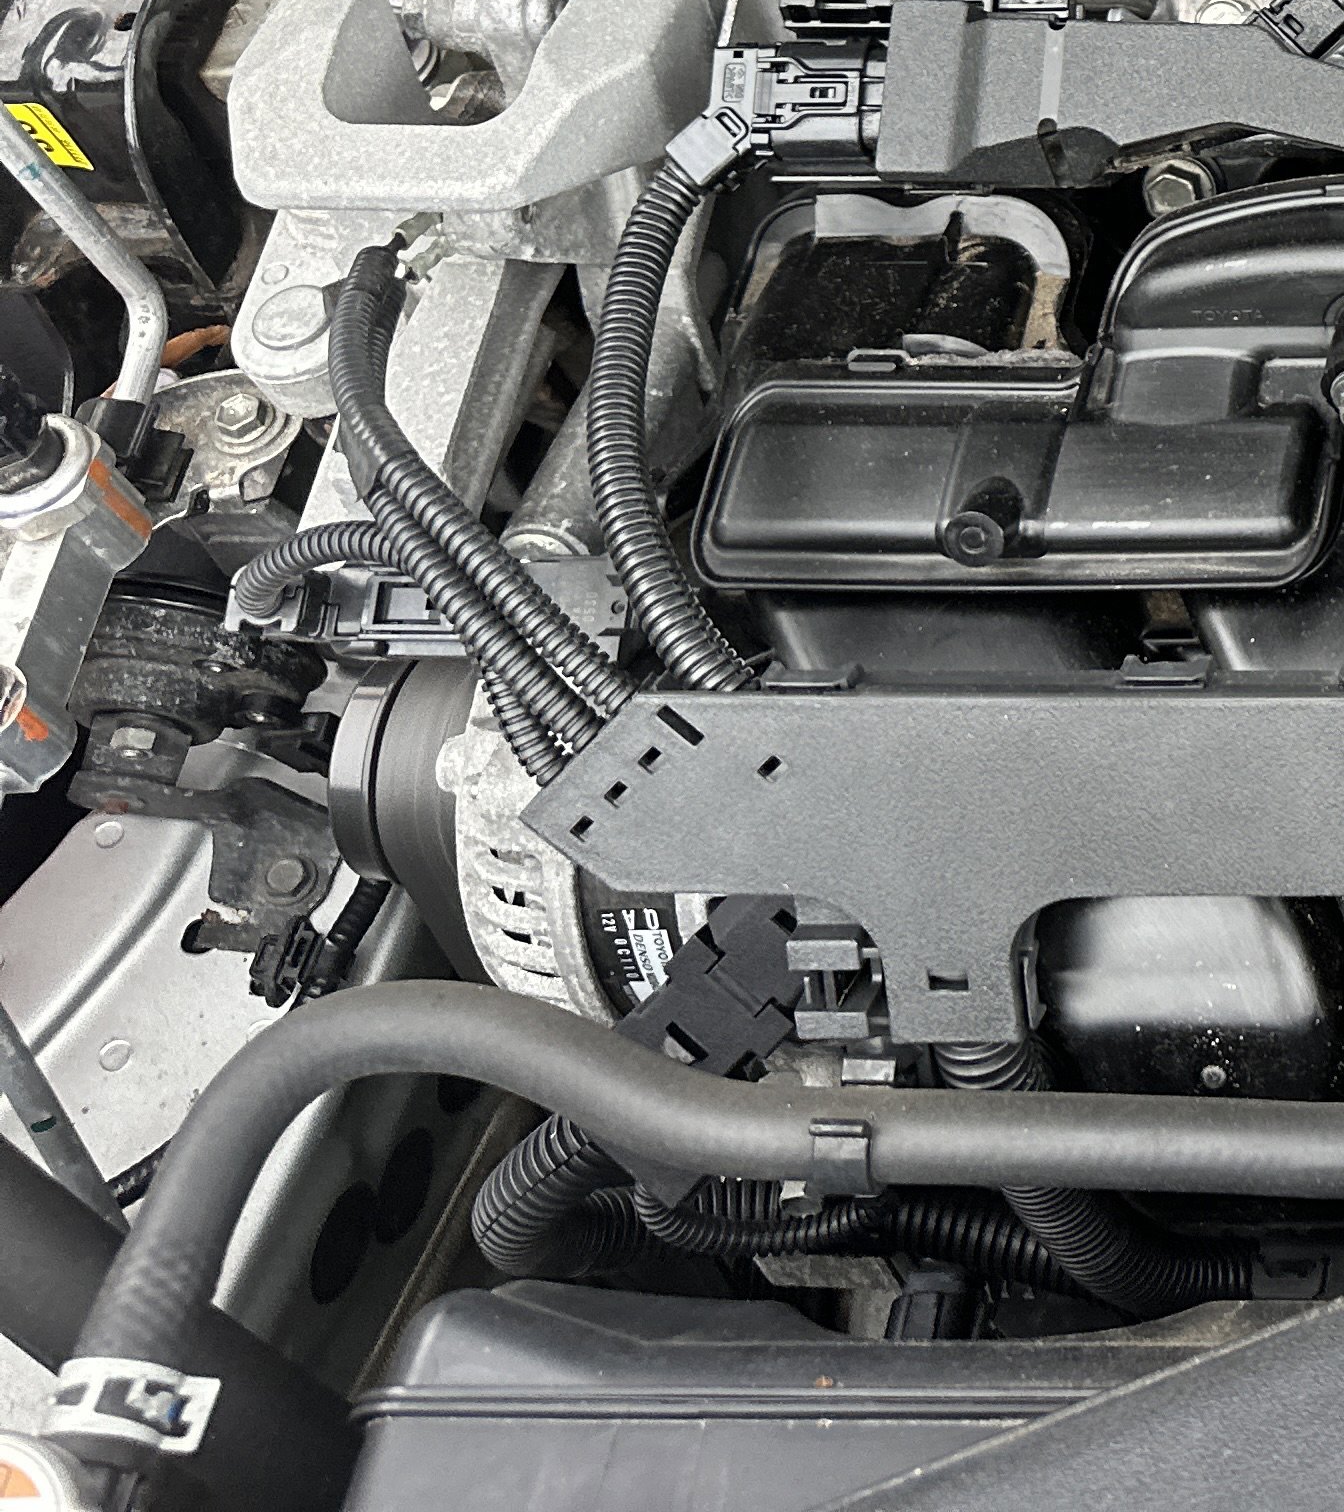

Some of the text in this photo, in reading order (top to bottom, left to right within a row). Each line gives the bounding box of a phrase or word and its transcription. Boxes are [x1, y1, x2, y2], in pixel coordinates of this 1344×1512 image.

[1190, 308, 1265, 322] TOYOTA
[601, 912, 618, 932] 12V
[632, 934, 654, 971] DENSO
